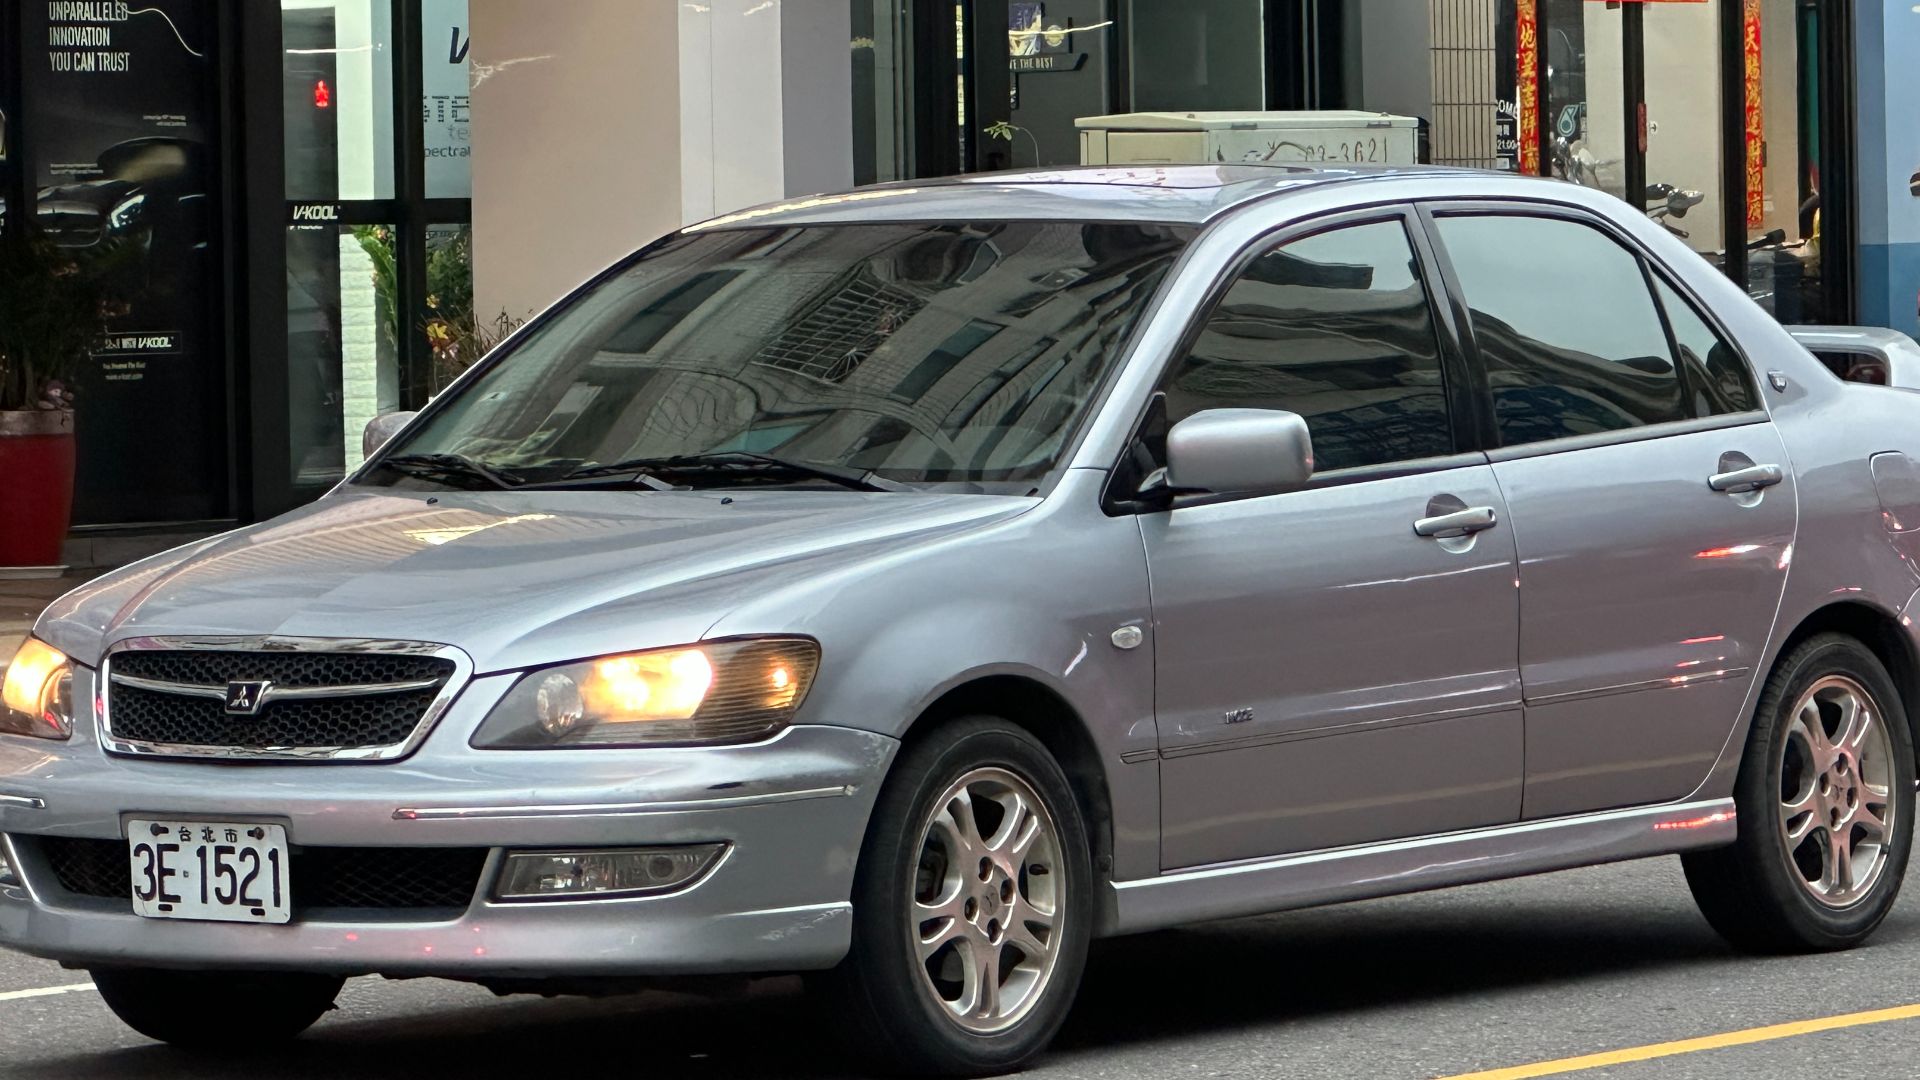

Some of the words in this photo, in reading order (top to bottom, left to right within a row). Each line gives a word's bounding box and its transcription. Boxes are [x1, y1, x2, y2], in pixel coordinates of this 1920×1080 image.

[49, 1, 129, 21] UNPARALLELED
[49, 27, 110, 46] INNOVATION
[50, 52, 71, 71] YOU
[74, 52, 95, 71] CAN
[97, 52, 130, 71] TRUST
[293, 205, 338, 220] V-KOOL
[137, 336, 172, 349] V-KOOL
[178, 826, 239, 843] 台北市
